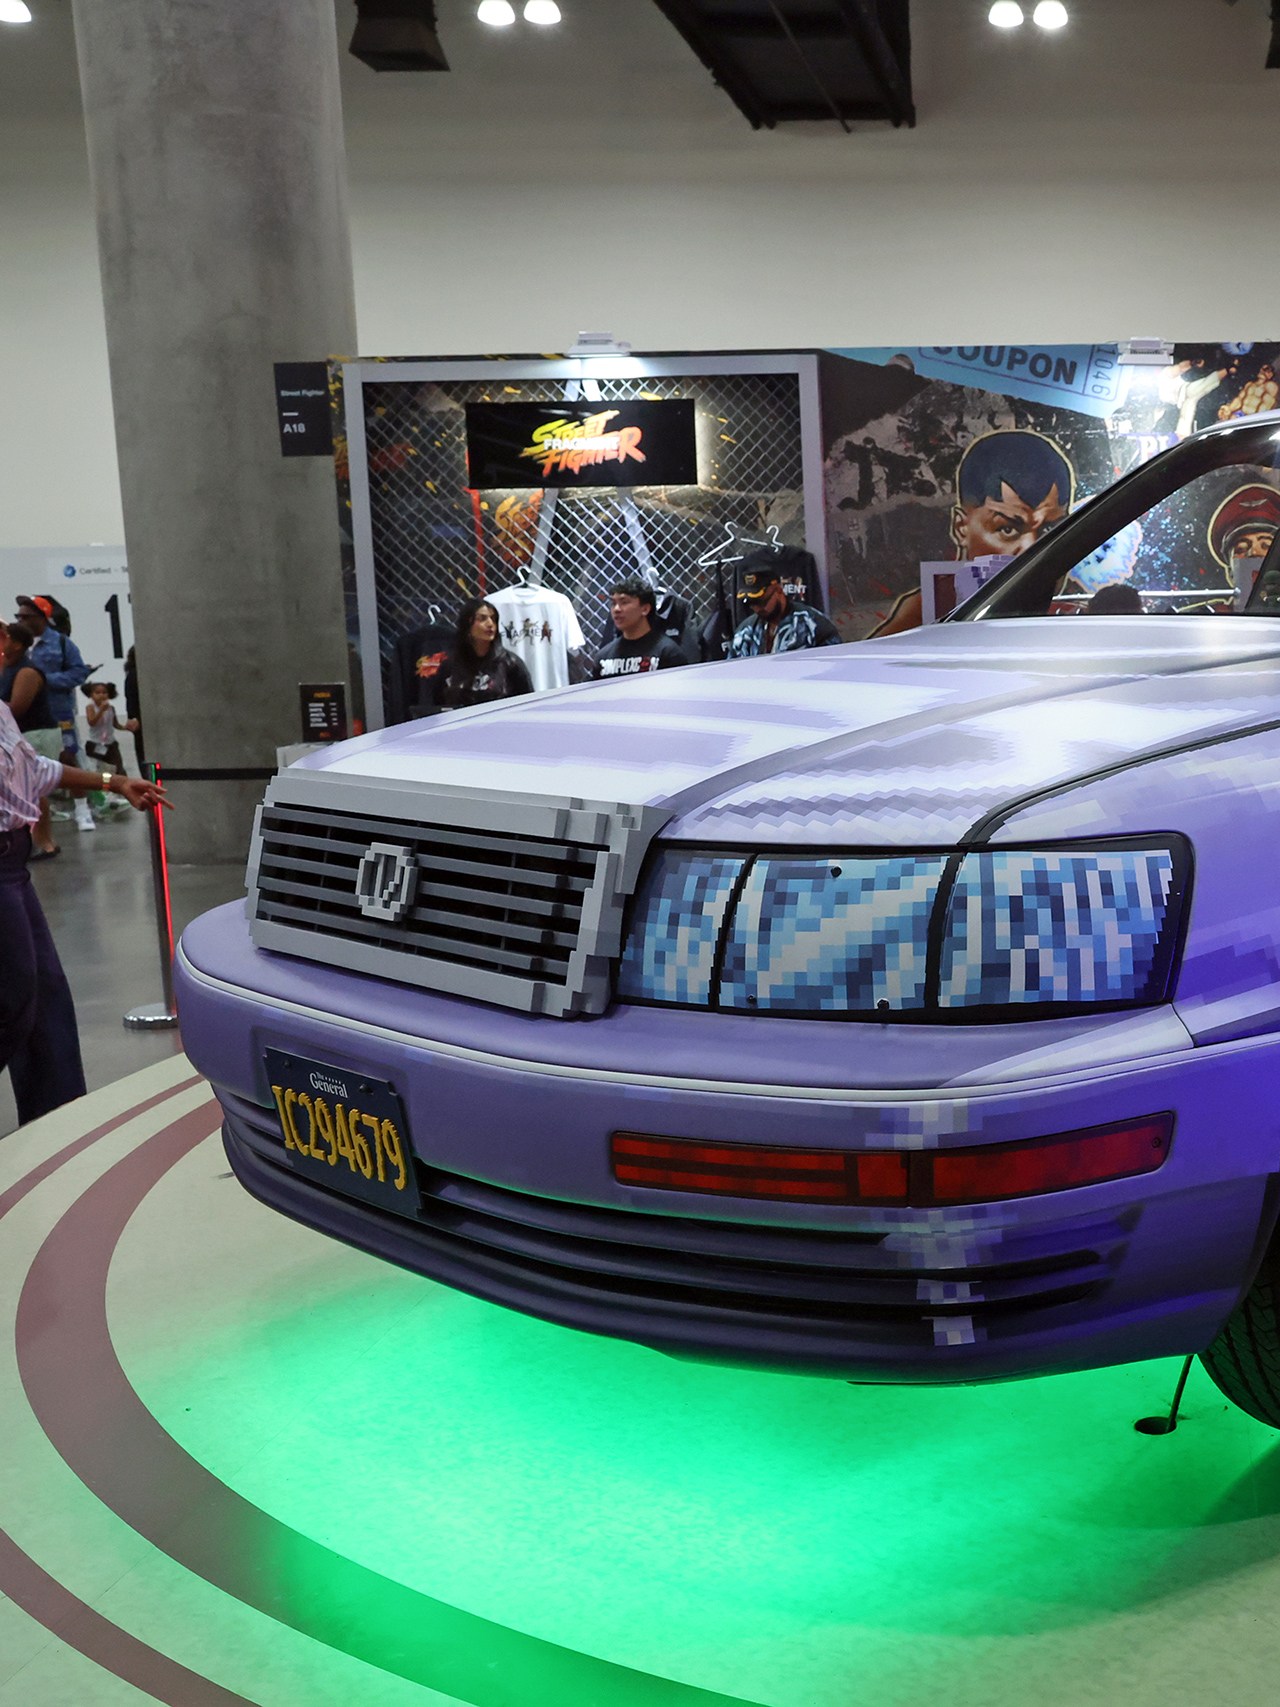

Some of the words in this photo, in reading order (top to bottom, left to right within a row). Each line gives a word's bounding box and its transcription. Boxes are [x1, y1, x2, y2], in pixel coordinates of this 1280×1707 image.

[280, 389, 300, 397] Street
[301, 389, 324, 397] Fighter
[522, 410, 620, 453] STREET
[533, 426, 646, 478] FIGHTER
[310, 1072, 348, 1098] General
